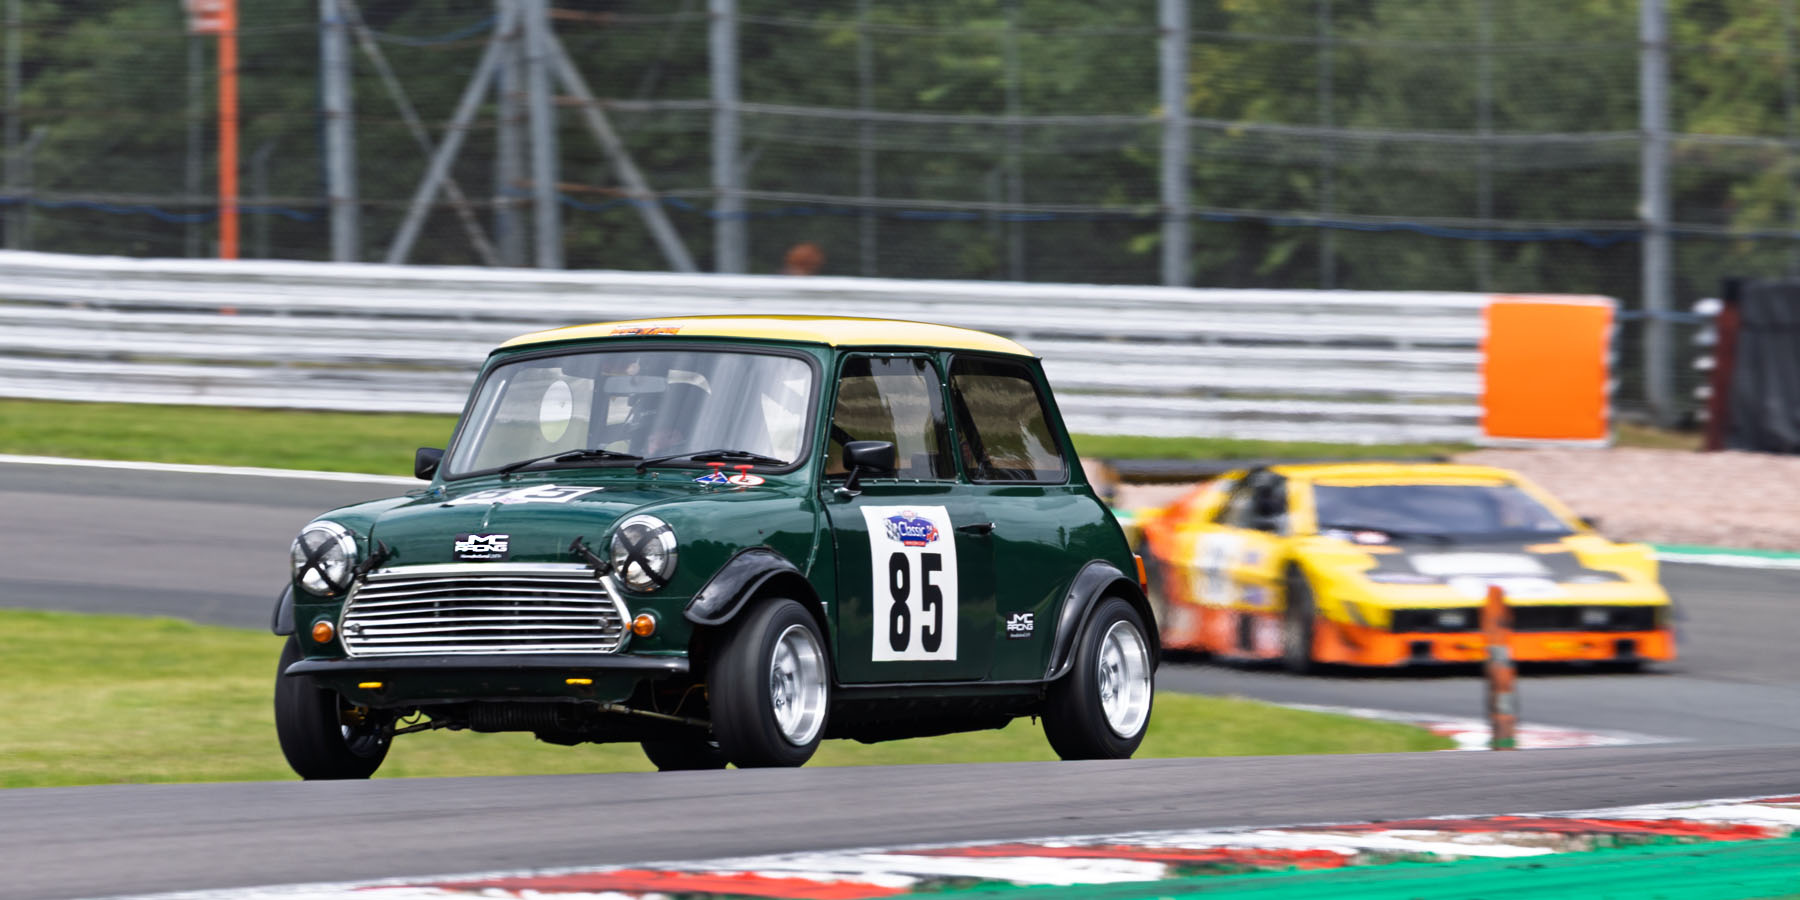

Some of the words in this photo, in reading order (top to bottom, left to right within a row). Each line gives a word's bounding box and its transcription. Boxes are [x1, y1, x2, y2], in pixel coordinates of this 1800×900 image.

[898, 522, 927, 537] Classic
[455, 535, 509, 545] JMC
[889, 552, 943, 652] 85
[1007, 613, 1034, 624] JMC
